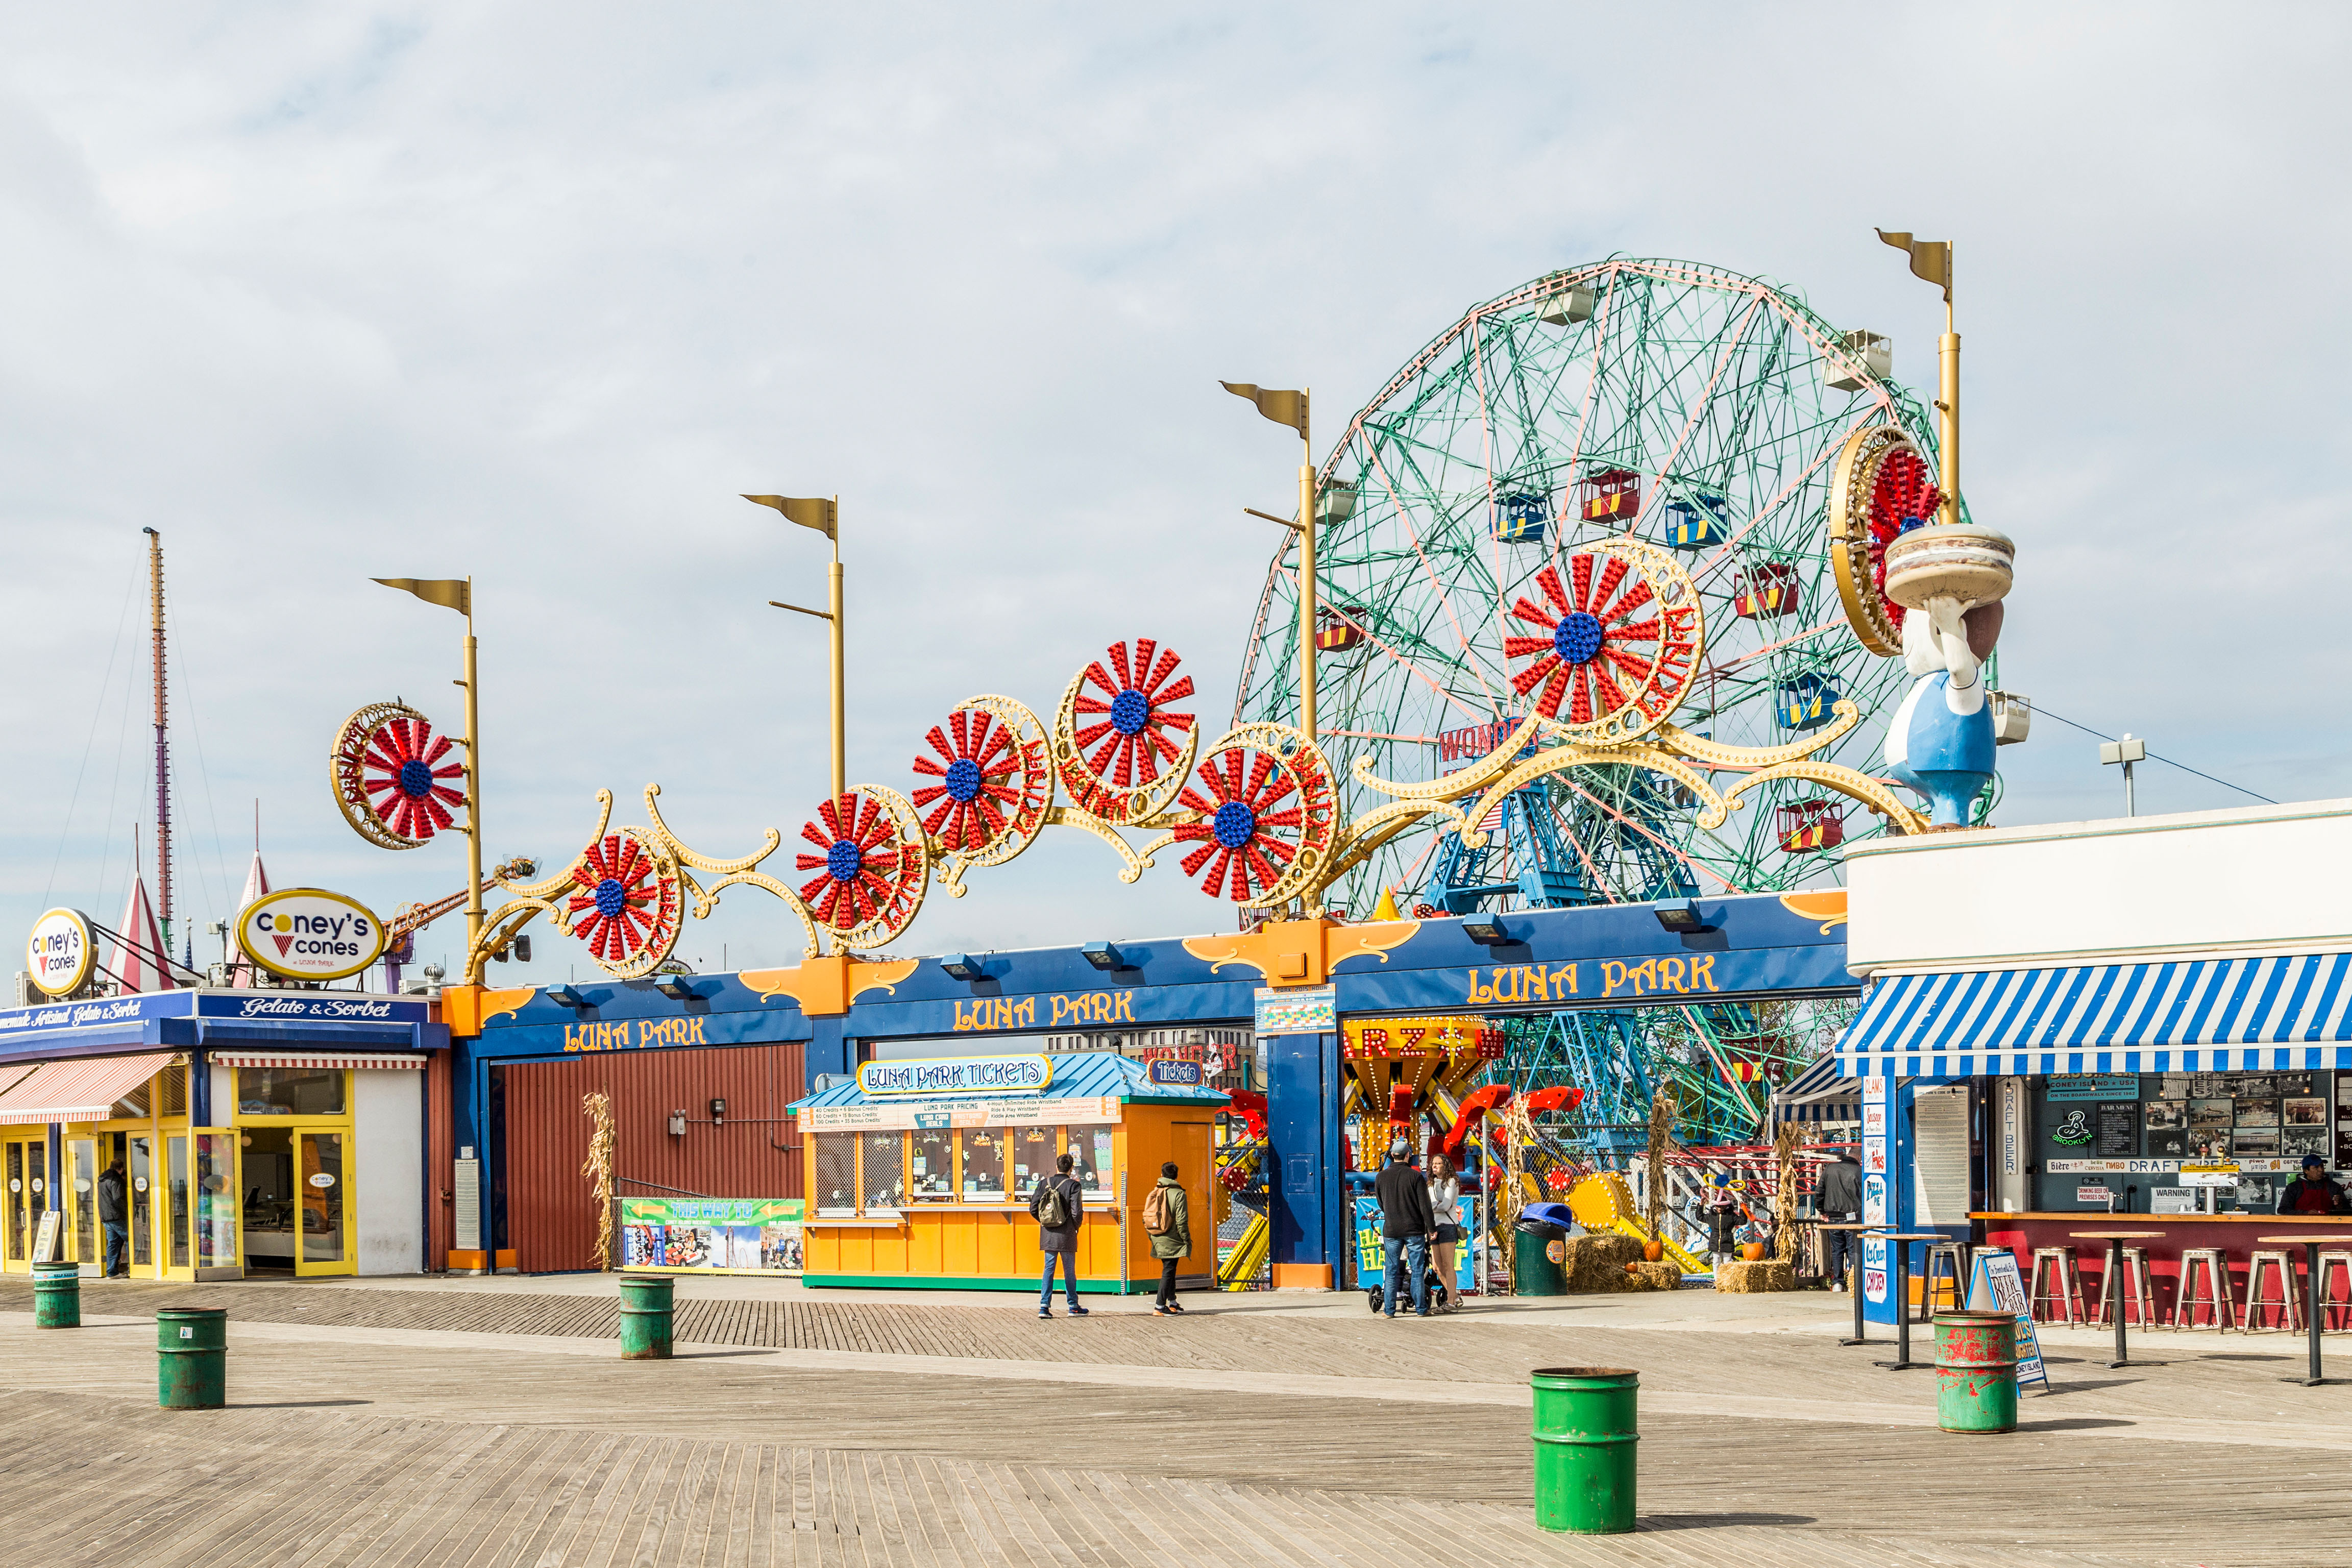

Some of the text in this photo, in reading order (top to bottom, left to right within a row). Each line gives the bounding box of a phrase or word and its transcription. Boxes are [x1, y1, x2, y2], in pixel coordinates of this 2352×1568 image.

[257, 913, 368, 940] coney's
[33, 927, 78, 954] coney's
[296, 940, 358, 955] cones
[49, 955, 75, 970] cones
[1467, 955, 1719, 1004] LUNA PARK
[72, 1004, 102, 1026] Gelato
[240, 998, 390, 1017] Gelato & Sorbet
[953, 991, 1136, 1031] LUNA PARK
[564, 1017, 706, 1052] LUNA PARK
[1143, 1044, 1237, 1070] WONDR
[866, 1060, 1042, 1089] LUNA PARK TICKETS
[1158, 1061, 1196, 1083] Tickets
[1866, 1078, 1882, 1094] CLAMS
[2005, 1087, 2014, 1170] DRAFT BEER
[2052, 1133, 2093, 1145] BROOKLYN
[2051, 1162, 2069, 1170] Bière
[2130, 1160, 2185, 1172] DRAFT
[671, 1202, 752, 1218] THIS WAY TO
[1867, 1272, 1884, 1293] CHICKEN
[1991, 1275, 2019, 1310] BEER
[2009, 1293, 2028, 1316] BAR
[2016, 1321, 2032, 1341] UL'S
[2016, 1341, 2037, 1360] UGHTER
[2027, 1361, 2041, 1372] ISLAND
